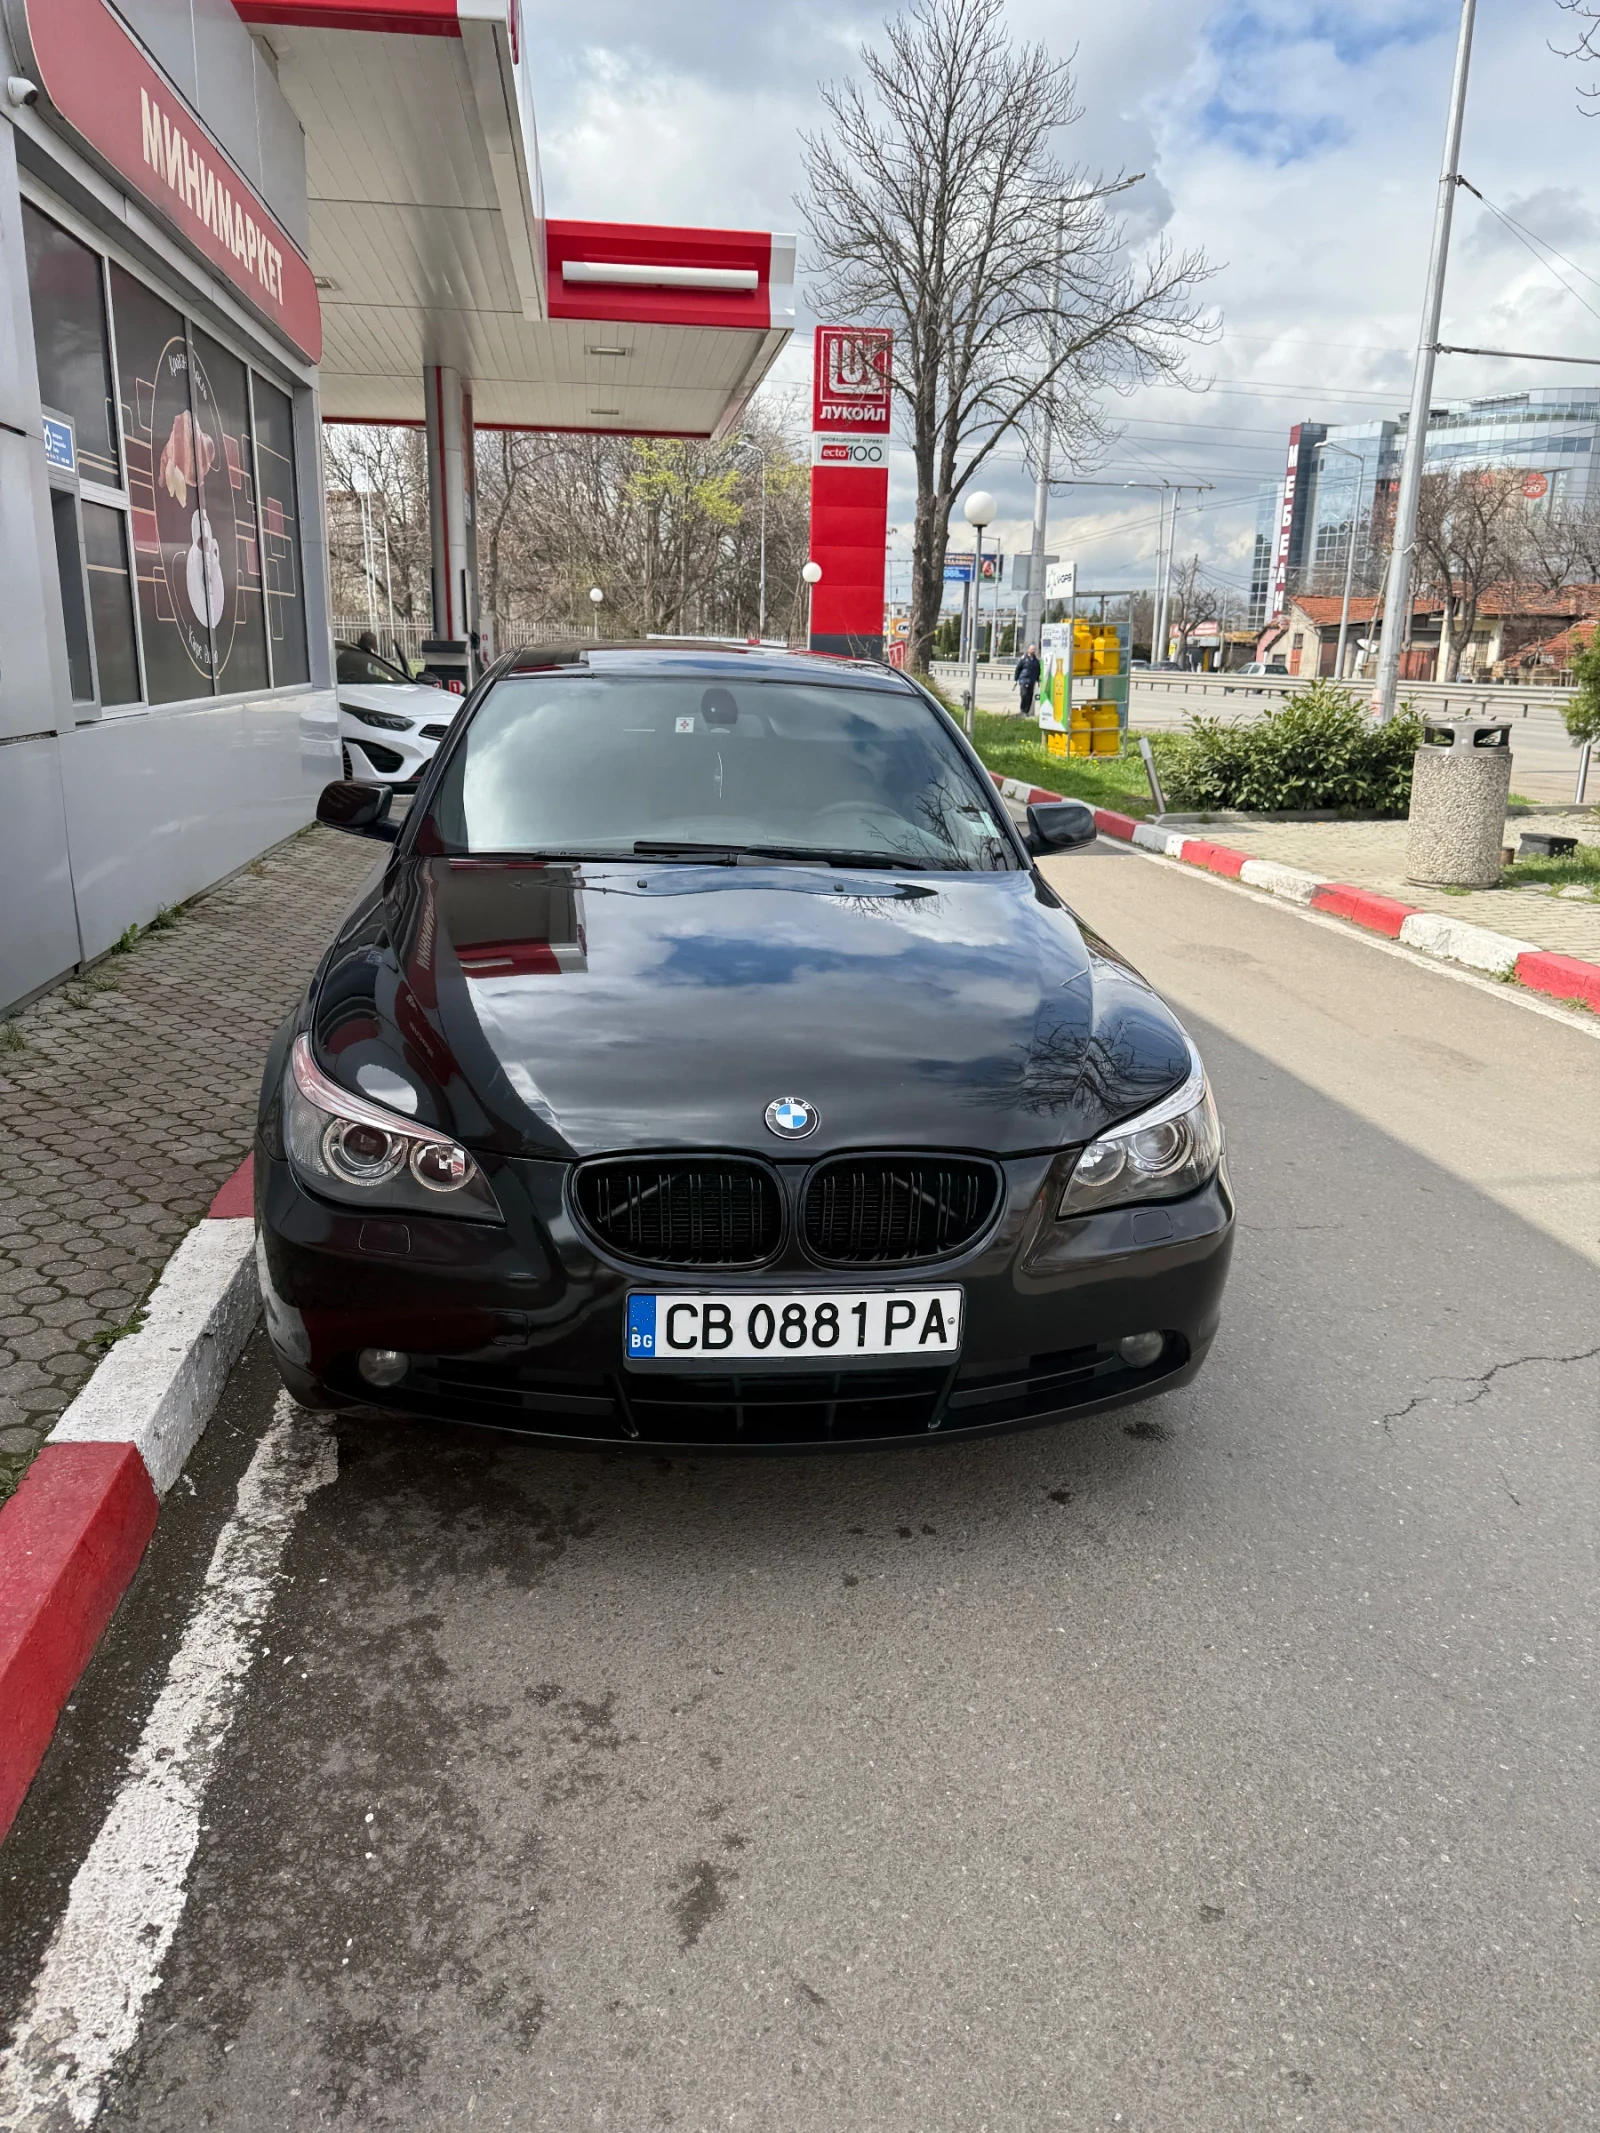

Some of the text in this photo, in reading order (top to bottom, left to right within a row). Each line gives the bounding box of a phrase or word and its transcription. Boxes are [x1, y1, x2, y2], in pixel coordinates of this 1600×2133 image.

[140, 87, 284, 306] МИНИМАРКЕТ
[820, 405, 886, 421] ЛУКОЙЛ
[1273, 444, 1299, 612] МЕБЕЛИ
[769, 1097, 812, 1110] BMW
[631, 1298, 948, 1350] BG CB 0881 PA
